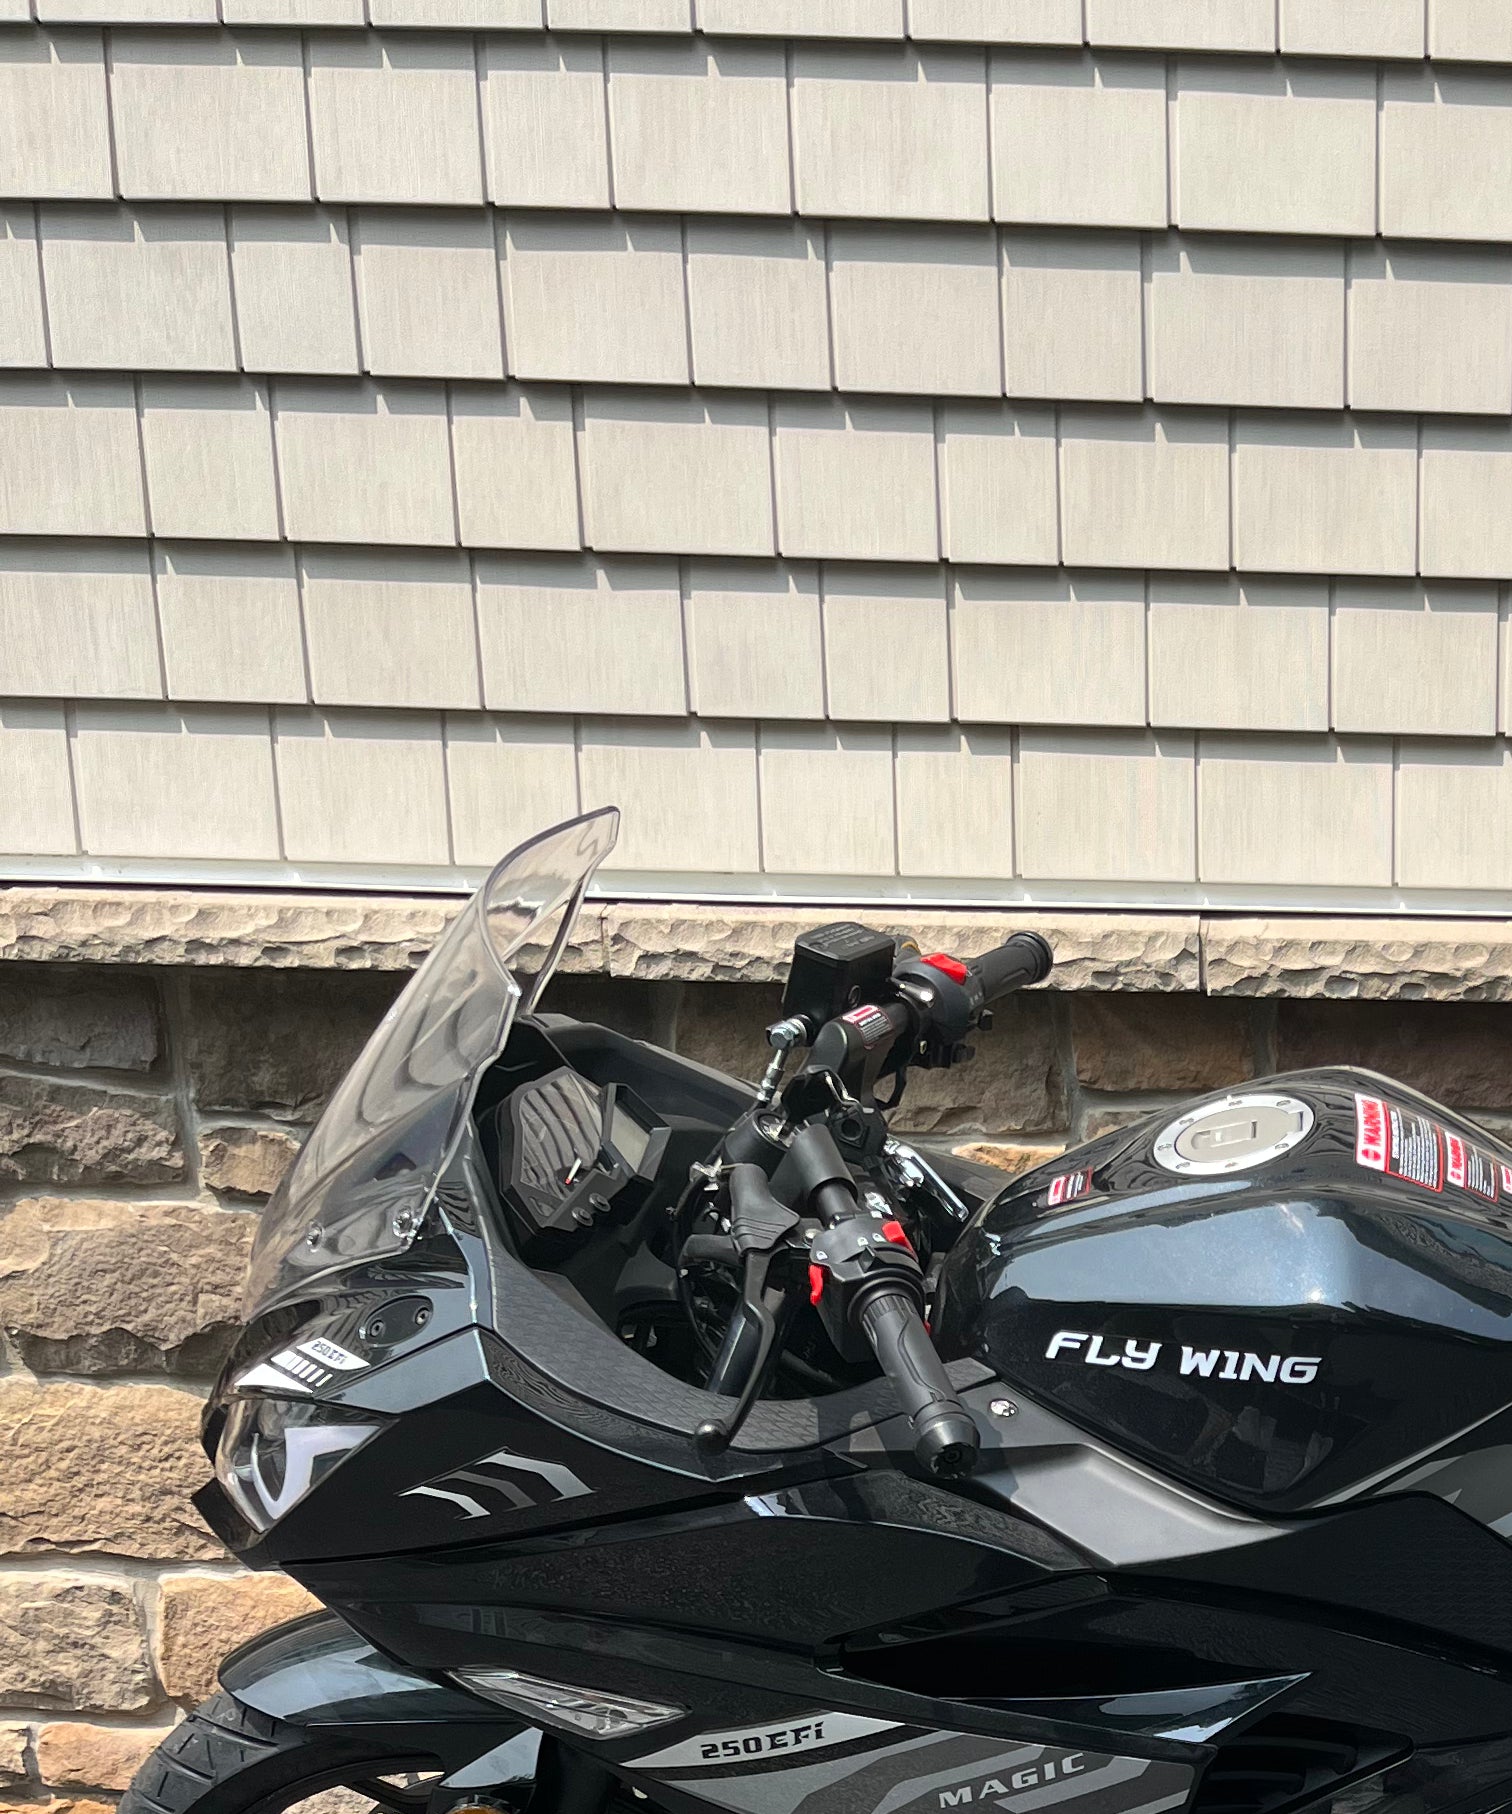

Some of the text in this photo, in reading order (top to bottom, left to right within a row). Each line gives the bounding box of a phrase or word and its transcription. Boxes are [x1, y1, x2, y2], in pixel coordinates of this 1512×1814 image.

[1045, 1331, 1323, 1384] FLY WING
[938, 1752, 1085, 1809] MAGIC
